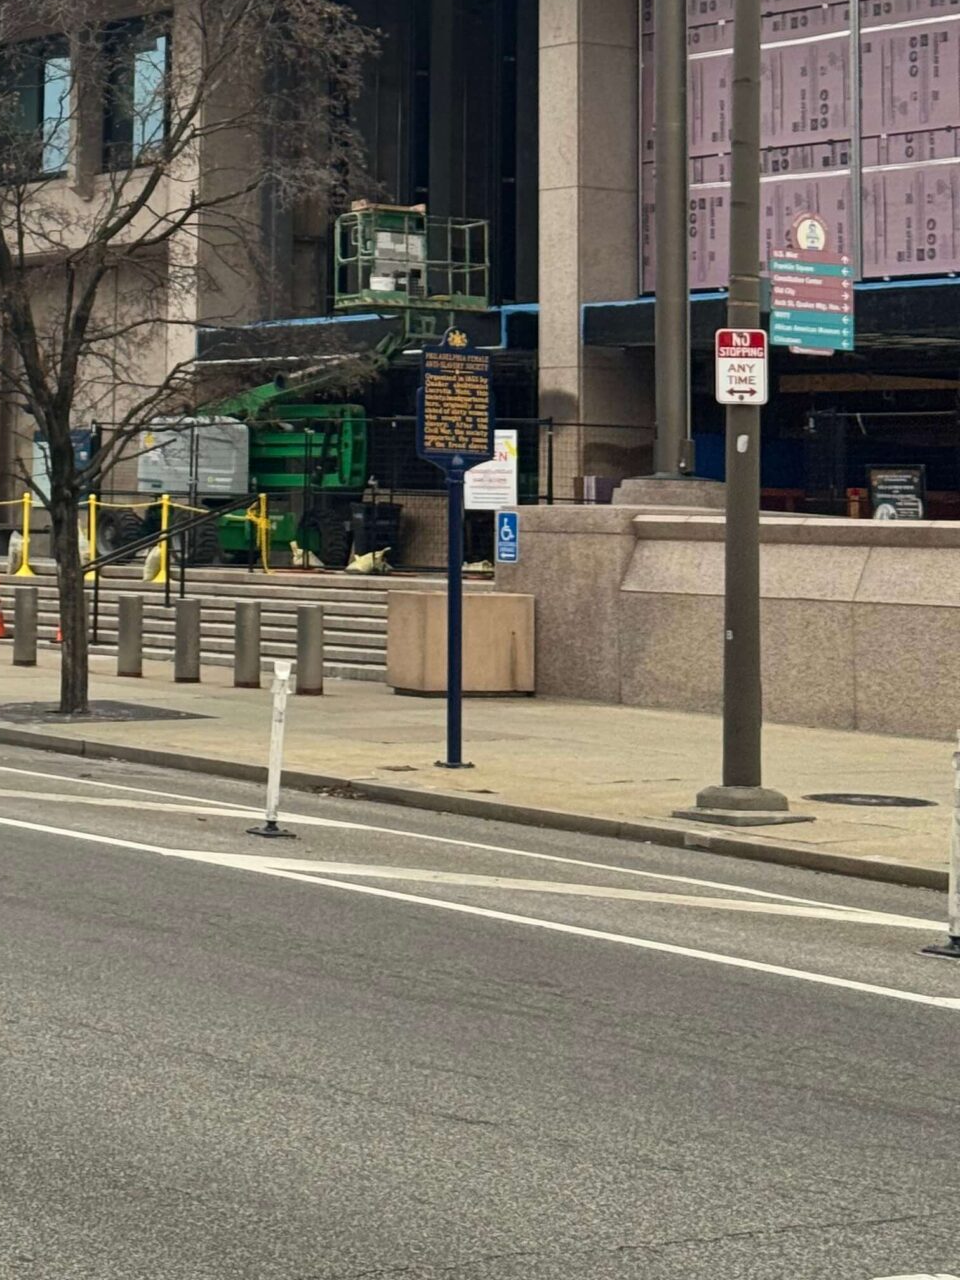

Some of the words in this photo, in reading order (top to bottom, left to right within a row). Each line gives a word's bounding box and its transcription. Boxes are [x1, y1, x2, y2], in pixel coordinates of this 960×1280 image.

[732, 333, 751, 347] NO
[719, 347, 764, 357] STOPPING
[728, 363, 755, 373] ANY
[727, 375, 756, 385] TIME
